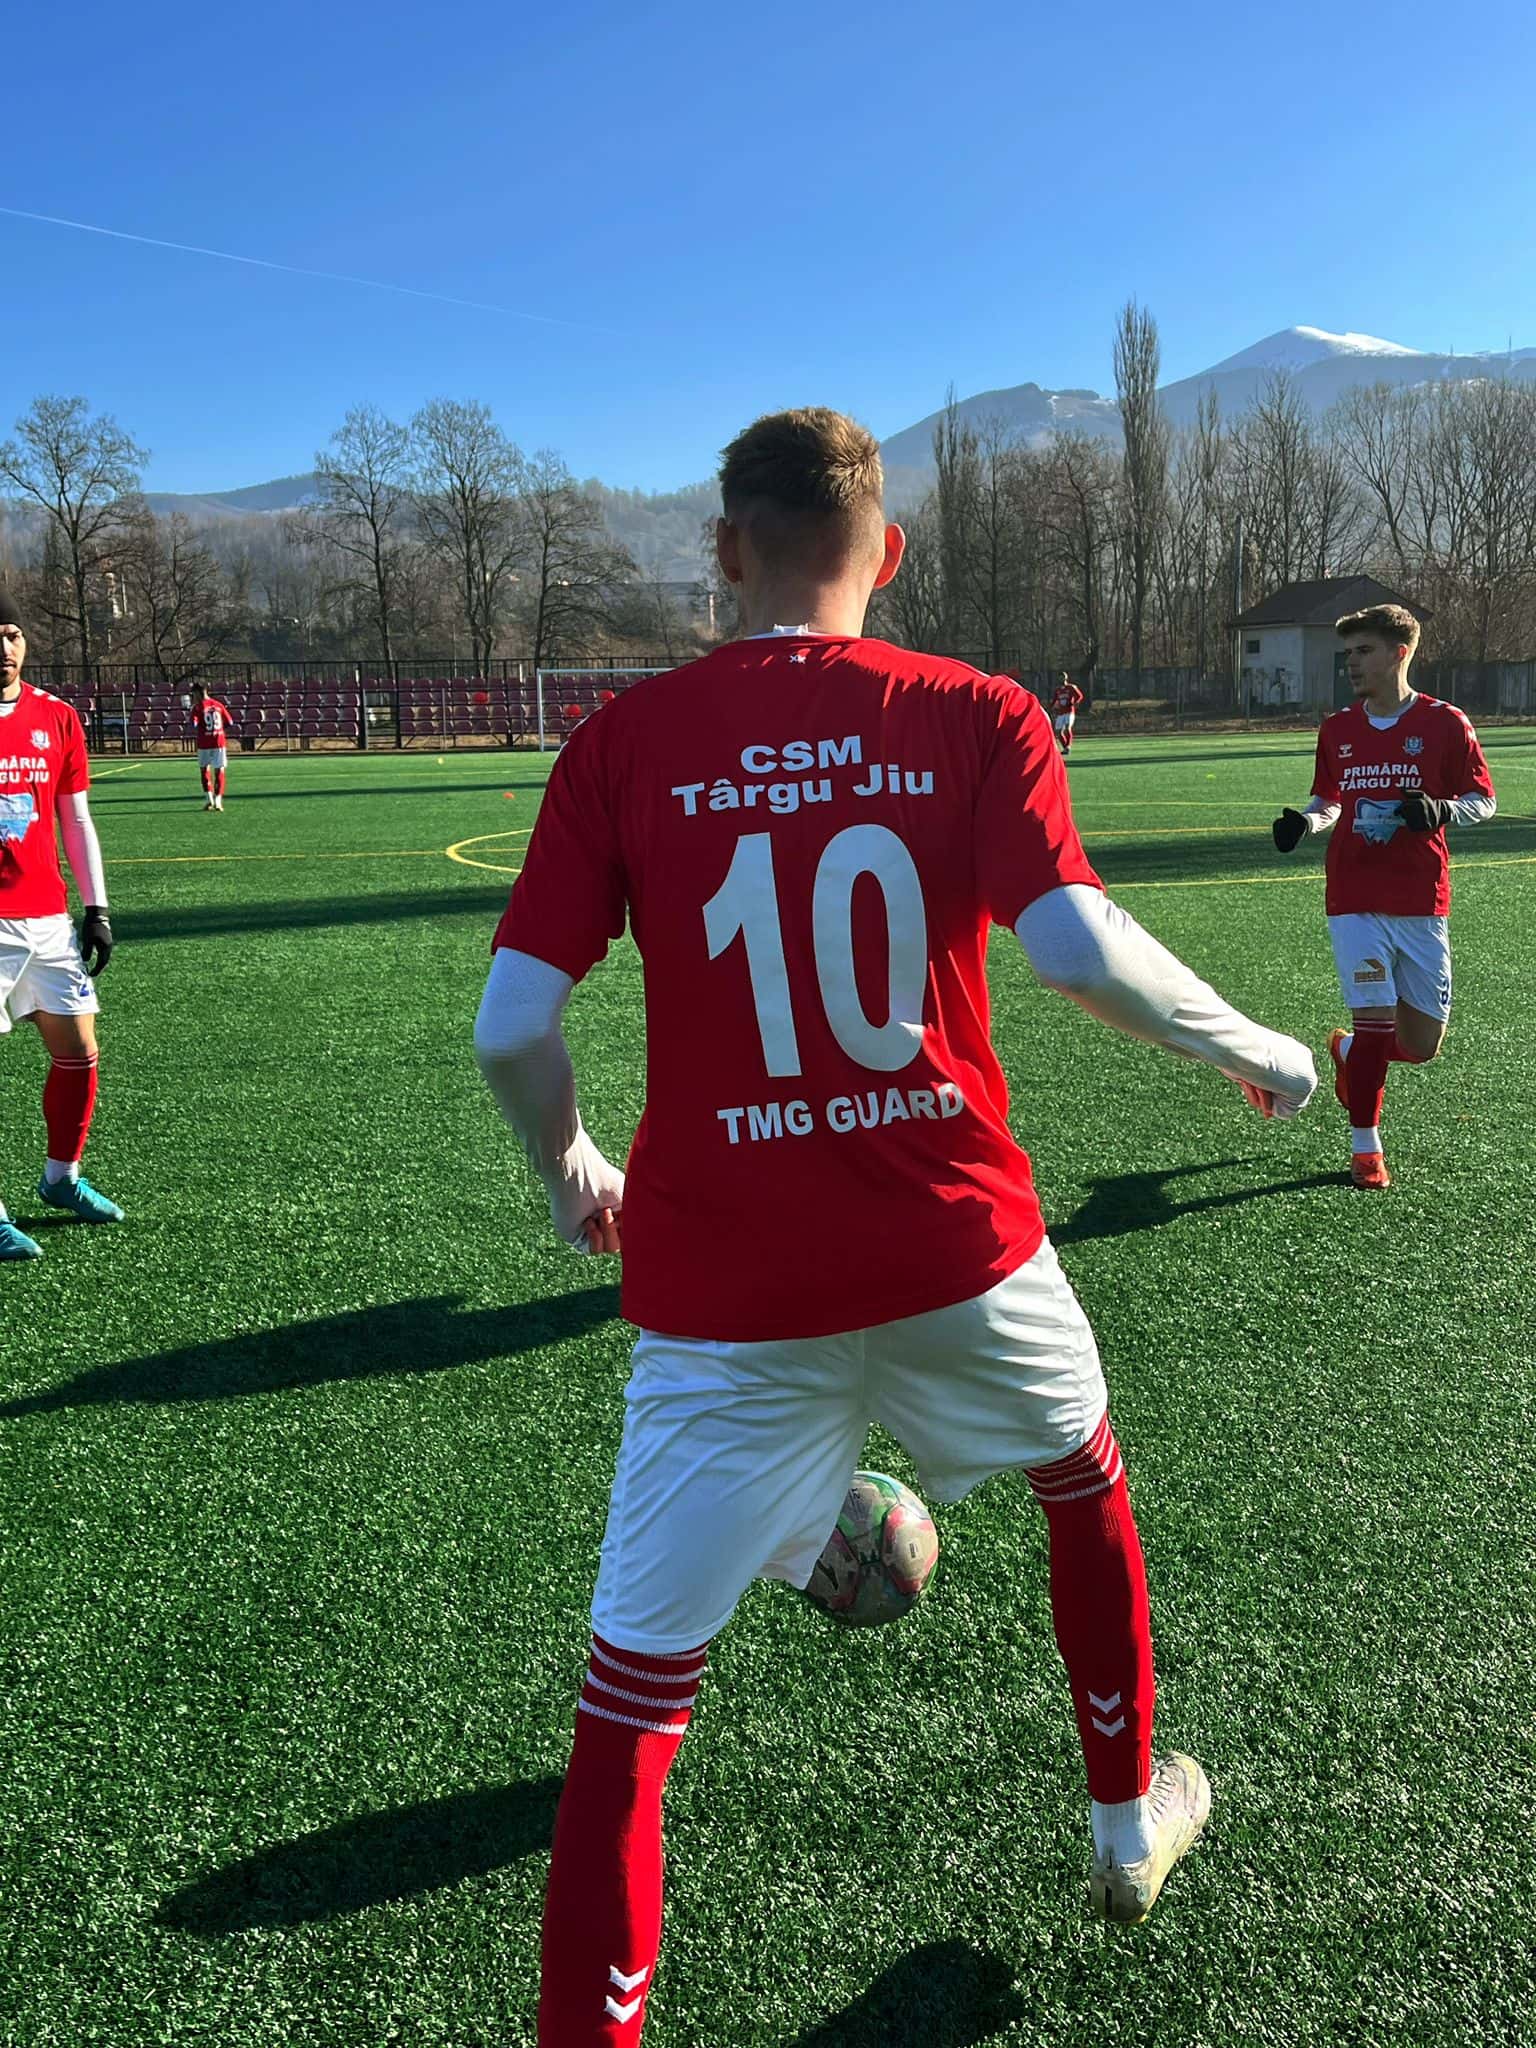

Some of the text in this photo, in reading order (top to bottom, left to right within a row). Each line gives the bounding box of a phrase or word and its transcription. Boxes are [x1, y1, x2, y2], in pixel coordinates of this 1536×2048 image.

[740, 735, 863, 774] CSM
[1343, 762, 1420, 779] PRIMĂRIA
[24, 770, 50, 784] JIU
[671, 763, 935, 816] Târgu Jiu
[1394, 777, 1423, 788] JIU
[702, 823, 928, 1078] 10
[716, 1082, 965, 1144] TMG GUARD
